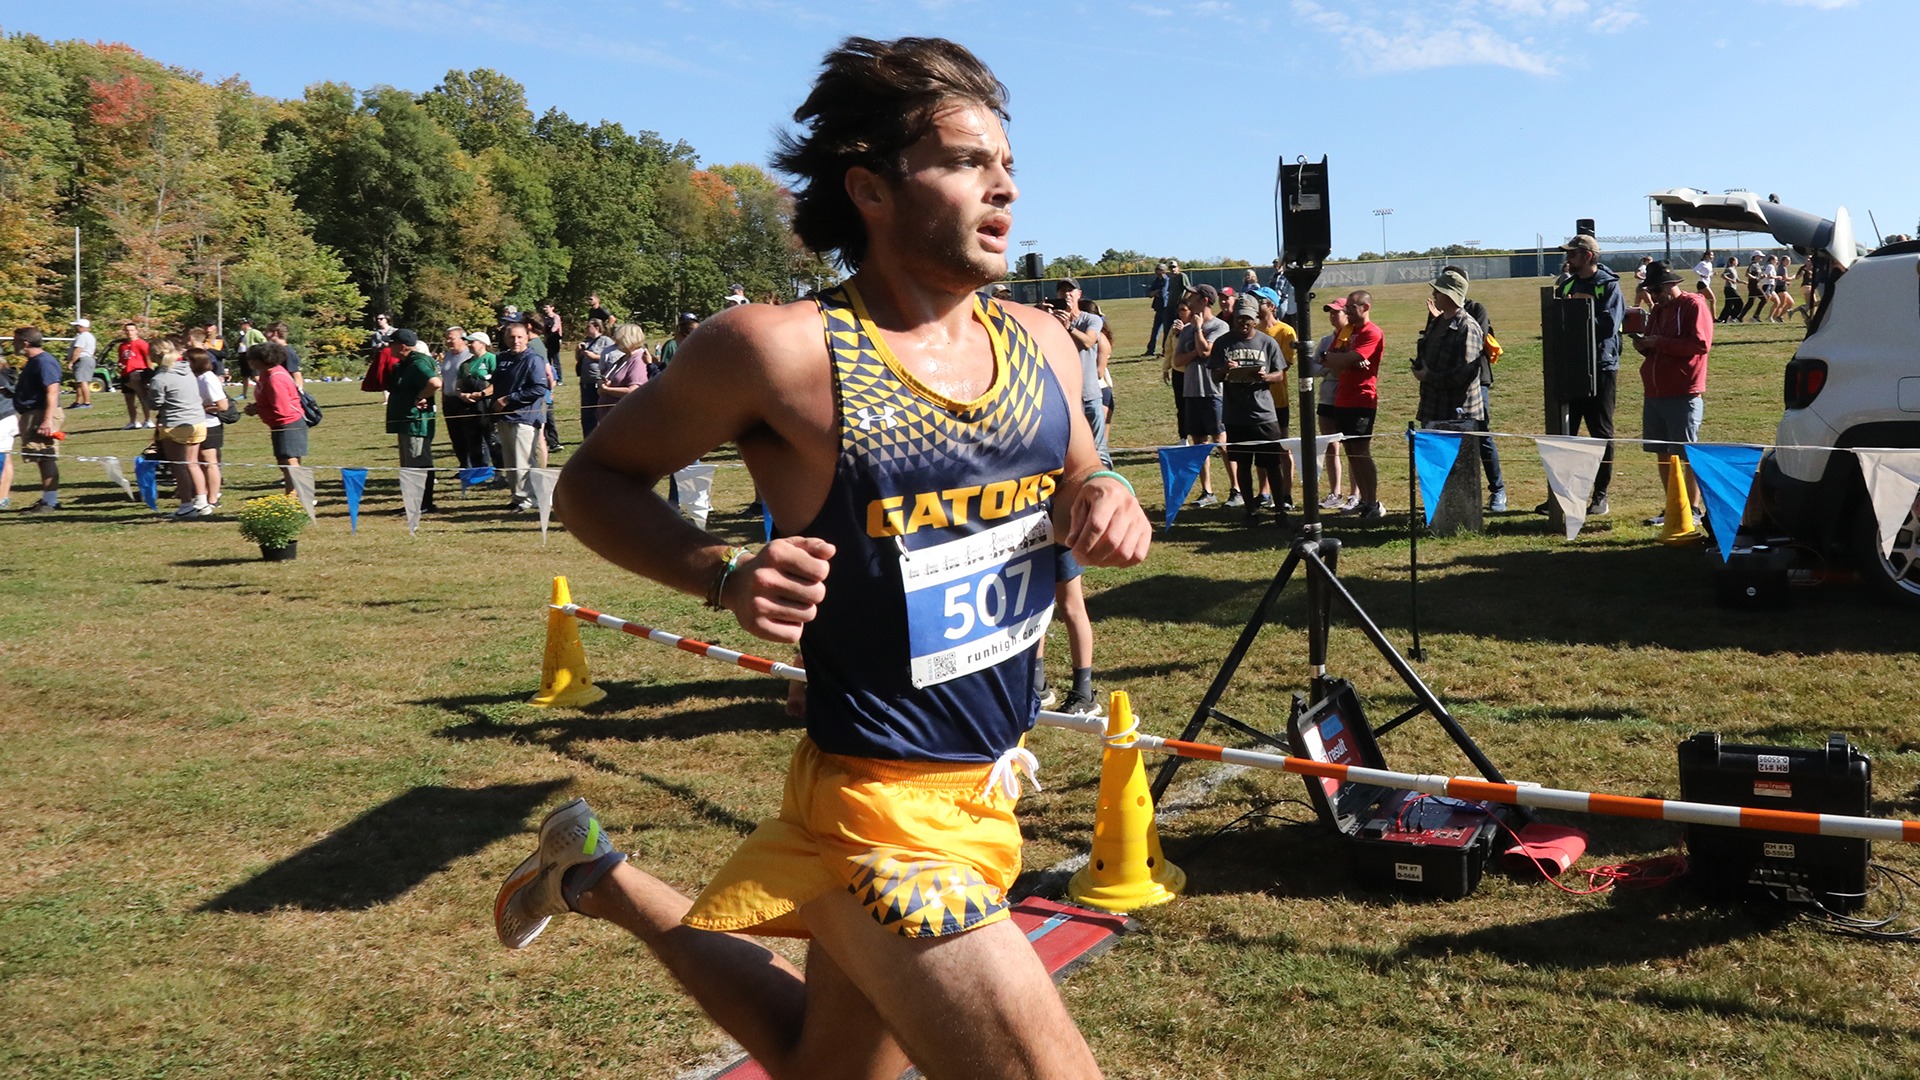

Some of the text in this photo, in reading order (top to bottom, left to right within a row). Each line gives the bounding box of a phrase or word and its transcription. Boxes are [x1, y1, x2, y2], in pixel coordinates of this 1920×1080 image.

[1228, 348, 1266, 361] GENEVA
[866, 467, 1063, 538] GATORS
[943, 559, 1032, 640] 507
[967, 624, 1041, 664] runhigh.com
[1328, 738, 1348, 763] result
[1777, 764, 1788, 772] RH
